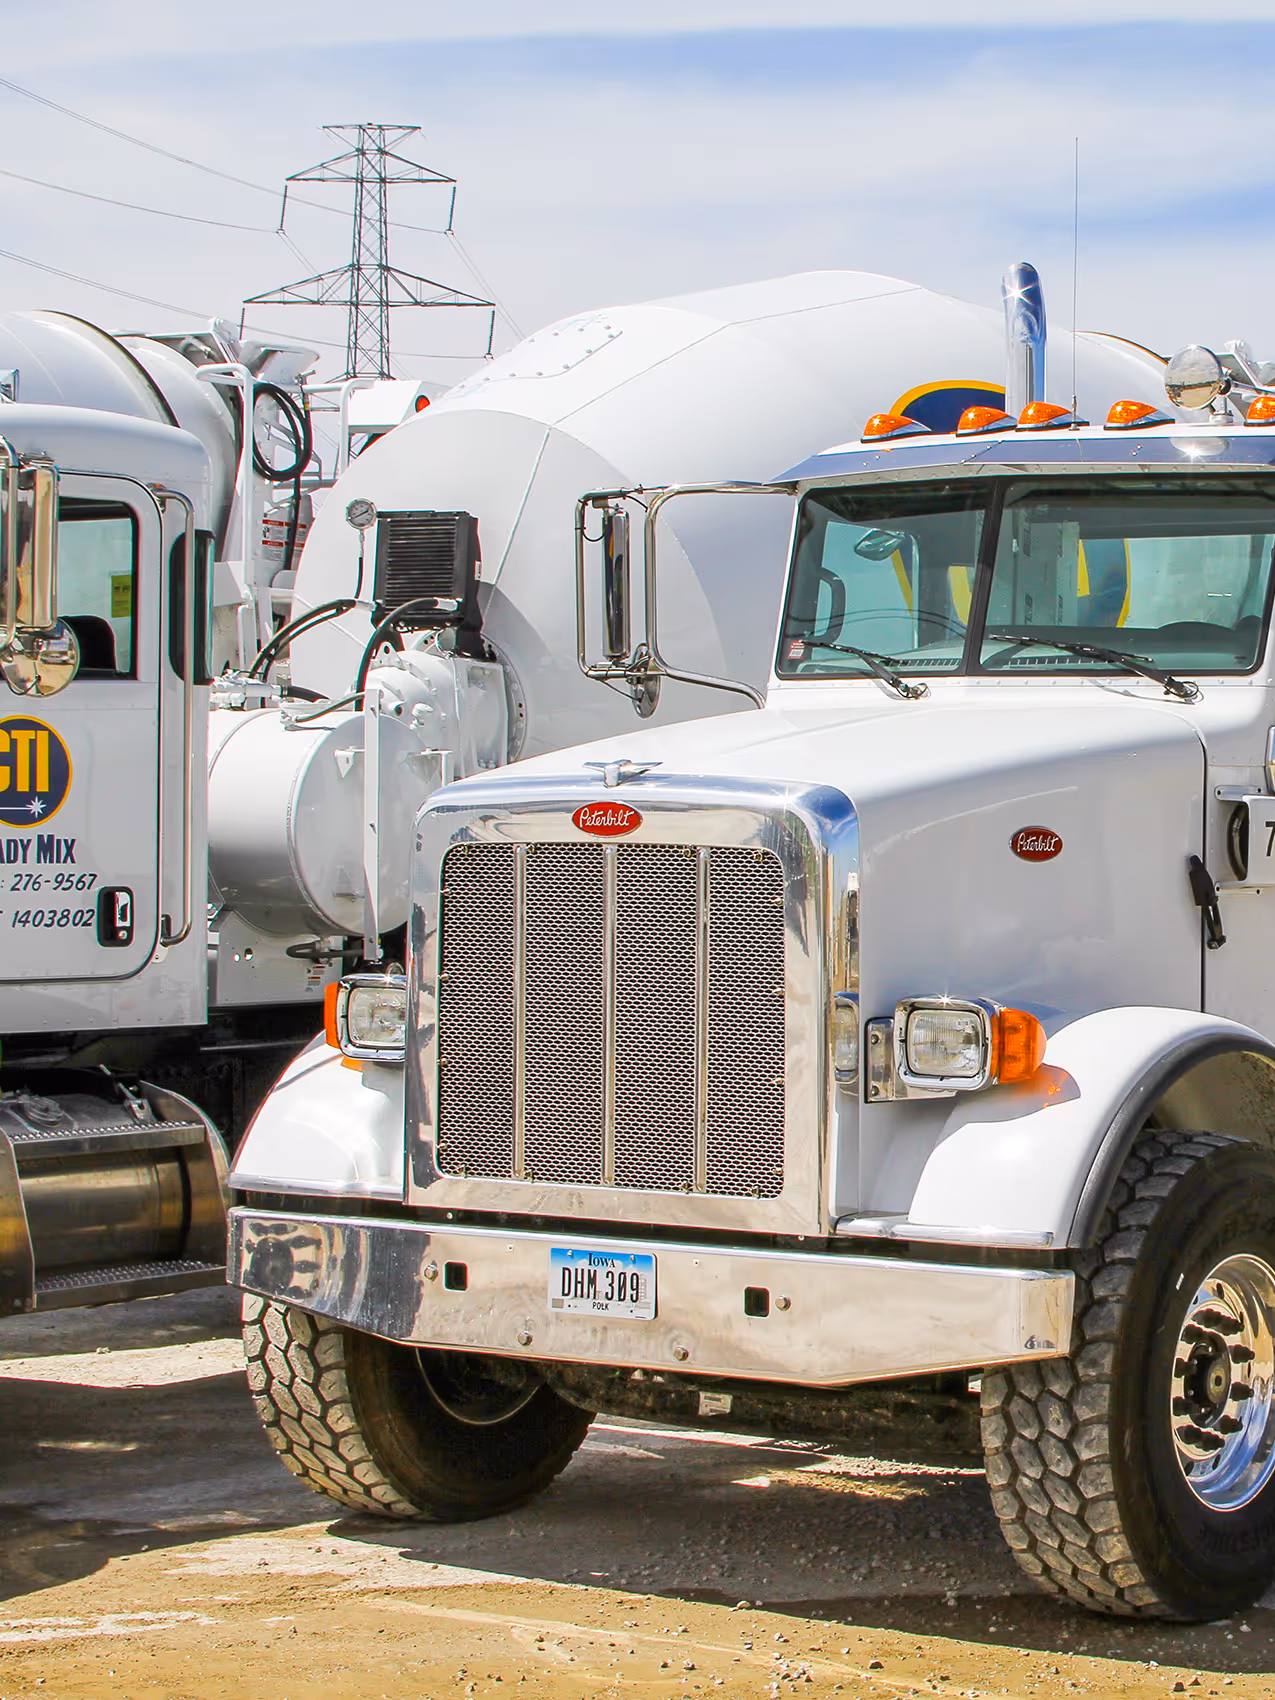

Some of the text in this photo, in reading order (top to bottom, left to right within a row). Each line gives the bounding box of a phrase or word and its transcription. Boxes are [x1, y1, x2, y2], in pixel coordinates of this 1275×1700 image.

[580, 807, 634, 828] Peterbilt
[36, 834, 76, 864] MIX
[1017, 832, 1059, 852] Peterbilt
[10, 872, 98, 892] 276-9567
[12, 908, 95, 928] 1403802
[562, 1267, 639, 1303] DHM 309
[592, 1302, 609, 1311] POLK
